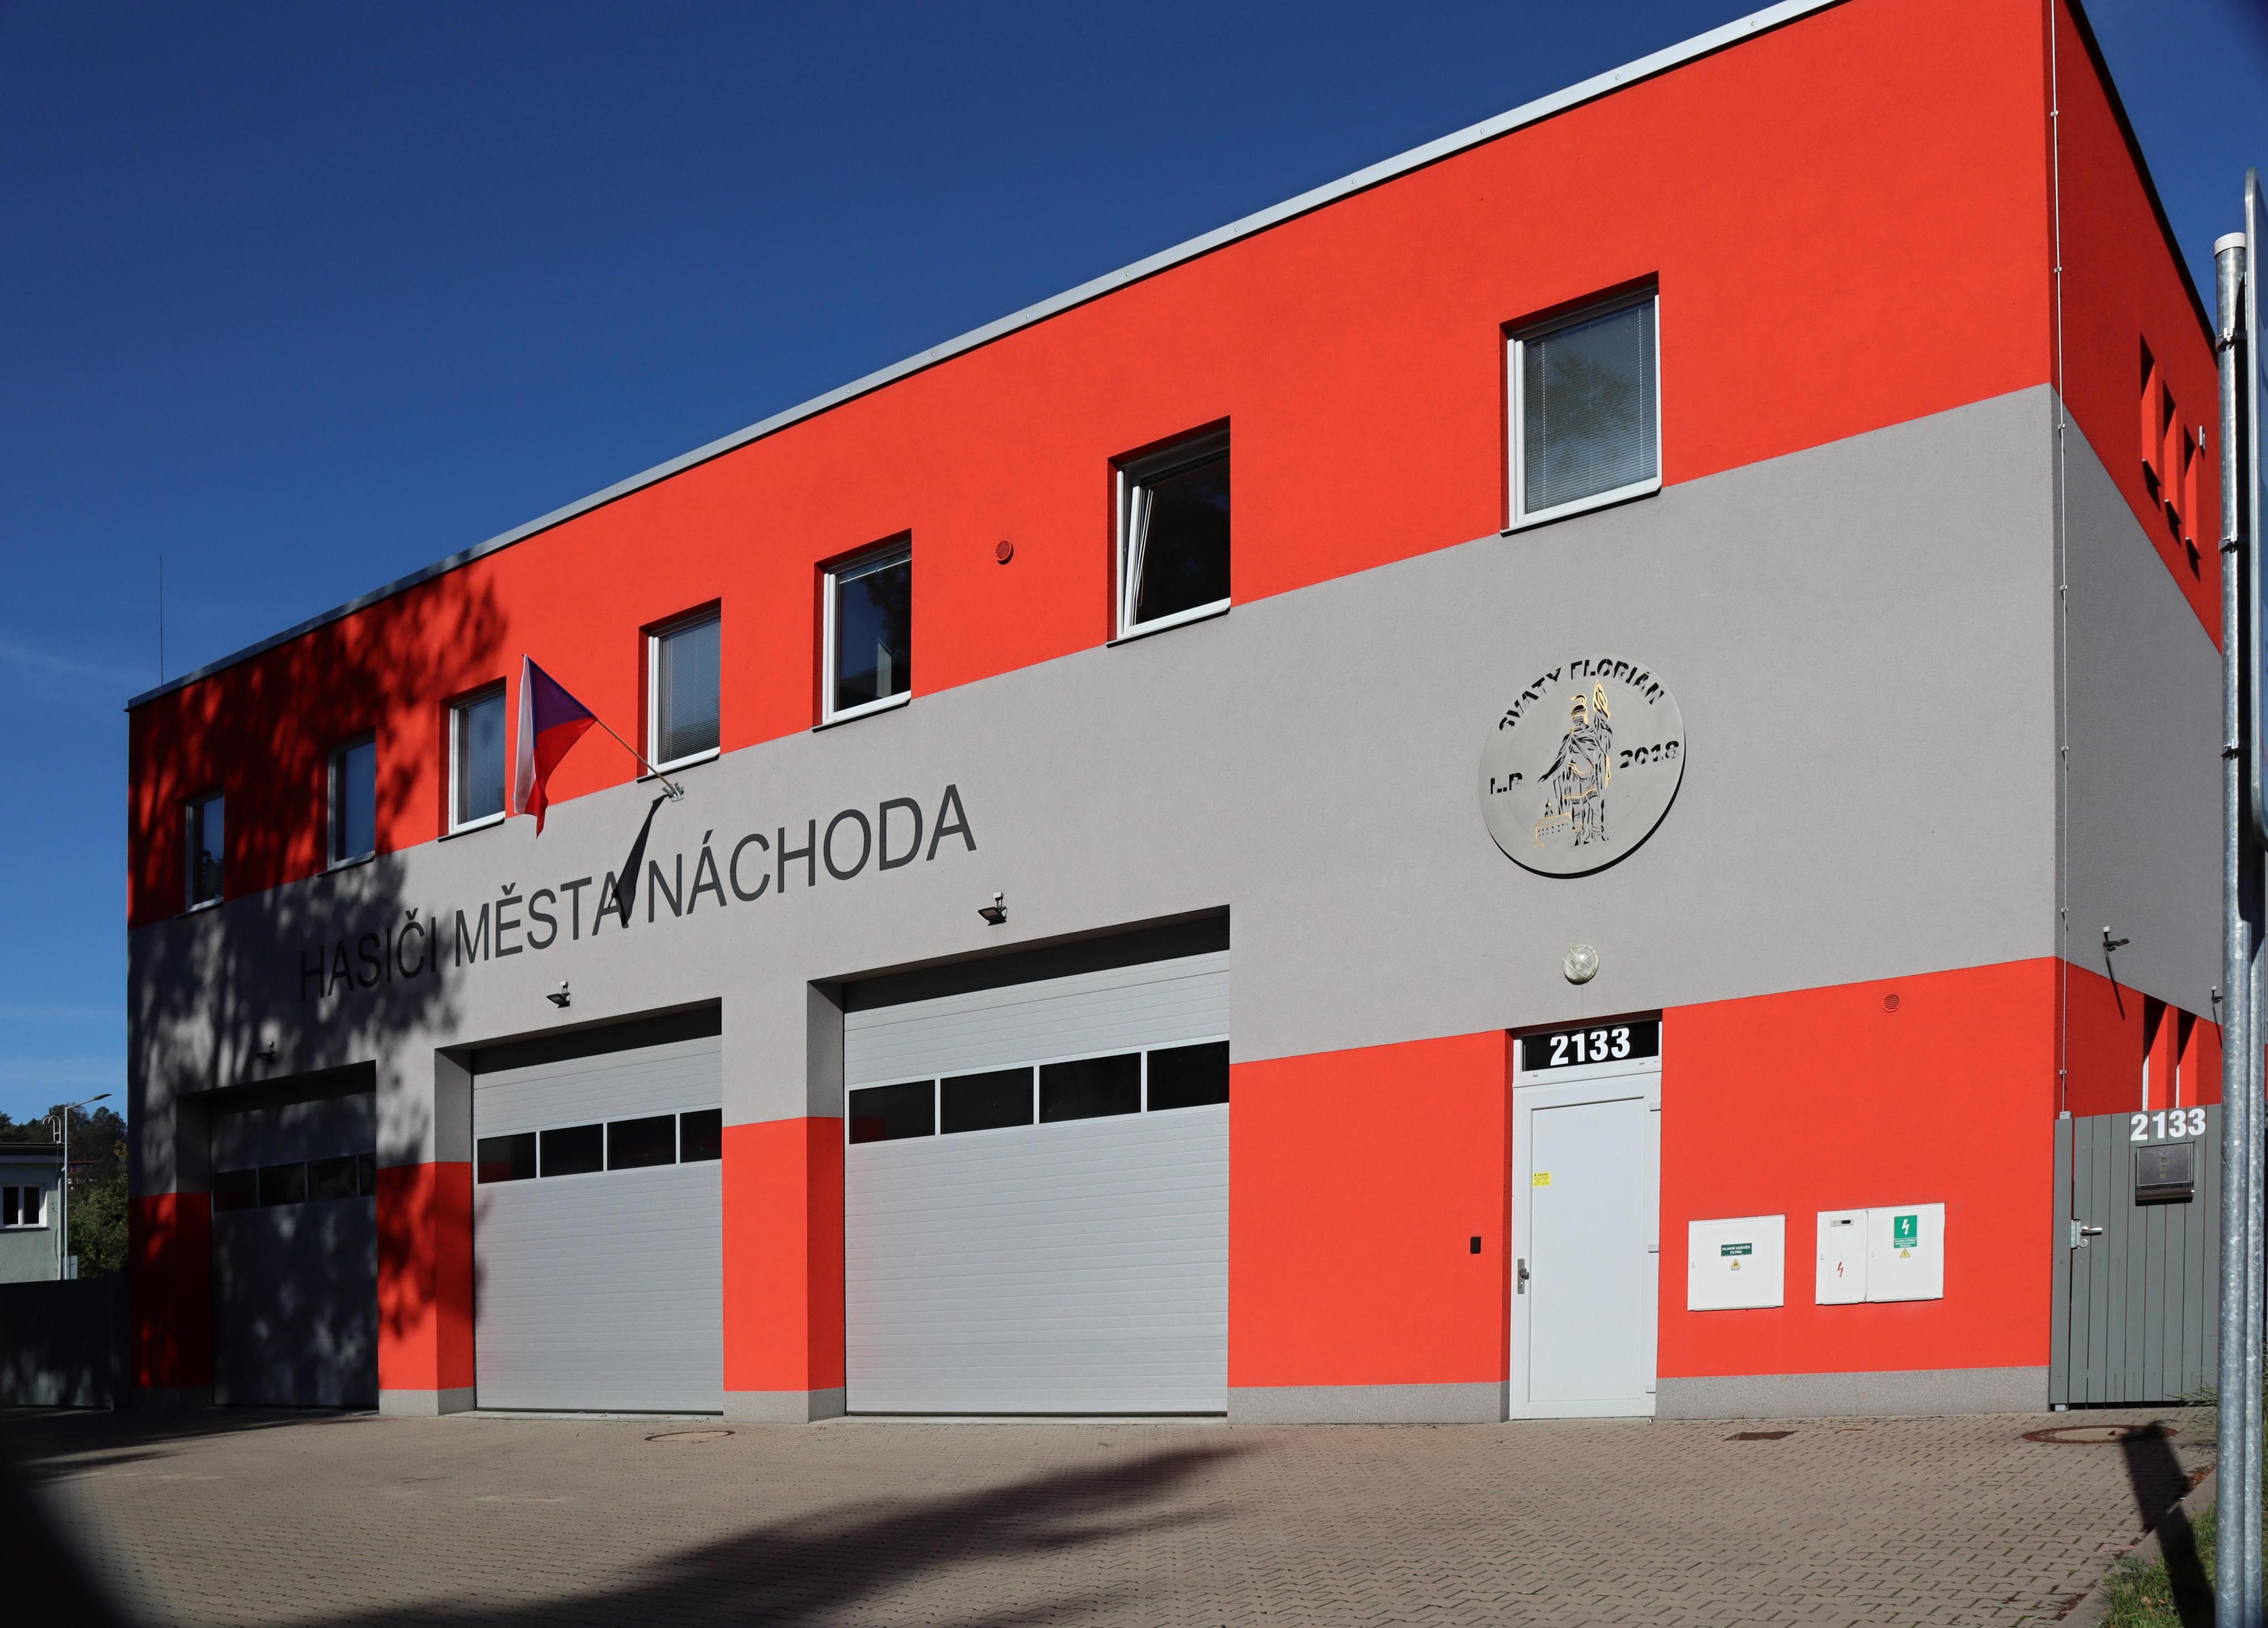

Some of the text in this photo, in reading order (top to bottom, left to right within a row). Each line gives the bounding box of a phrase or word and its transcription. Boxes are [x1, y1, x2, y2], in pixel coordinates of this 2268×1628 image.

[1620, 741, 1679, 768] 2018
[301, 784, 977, 1002] HASIČI MĚSTA NÁCHODA
[1550, 1025, 1630, 1066] 2133
[2130, 1108, 2206, 1141] 2133
